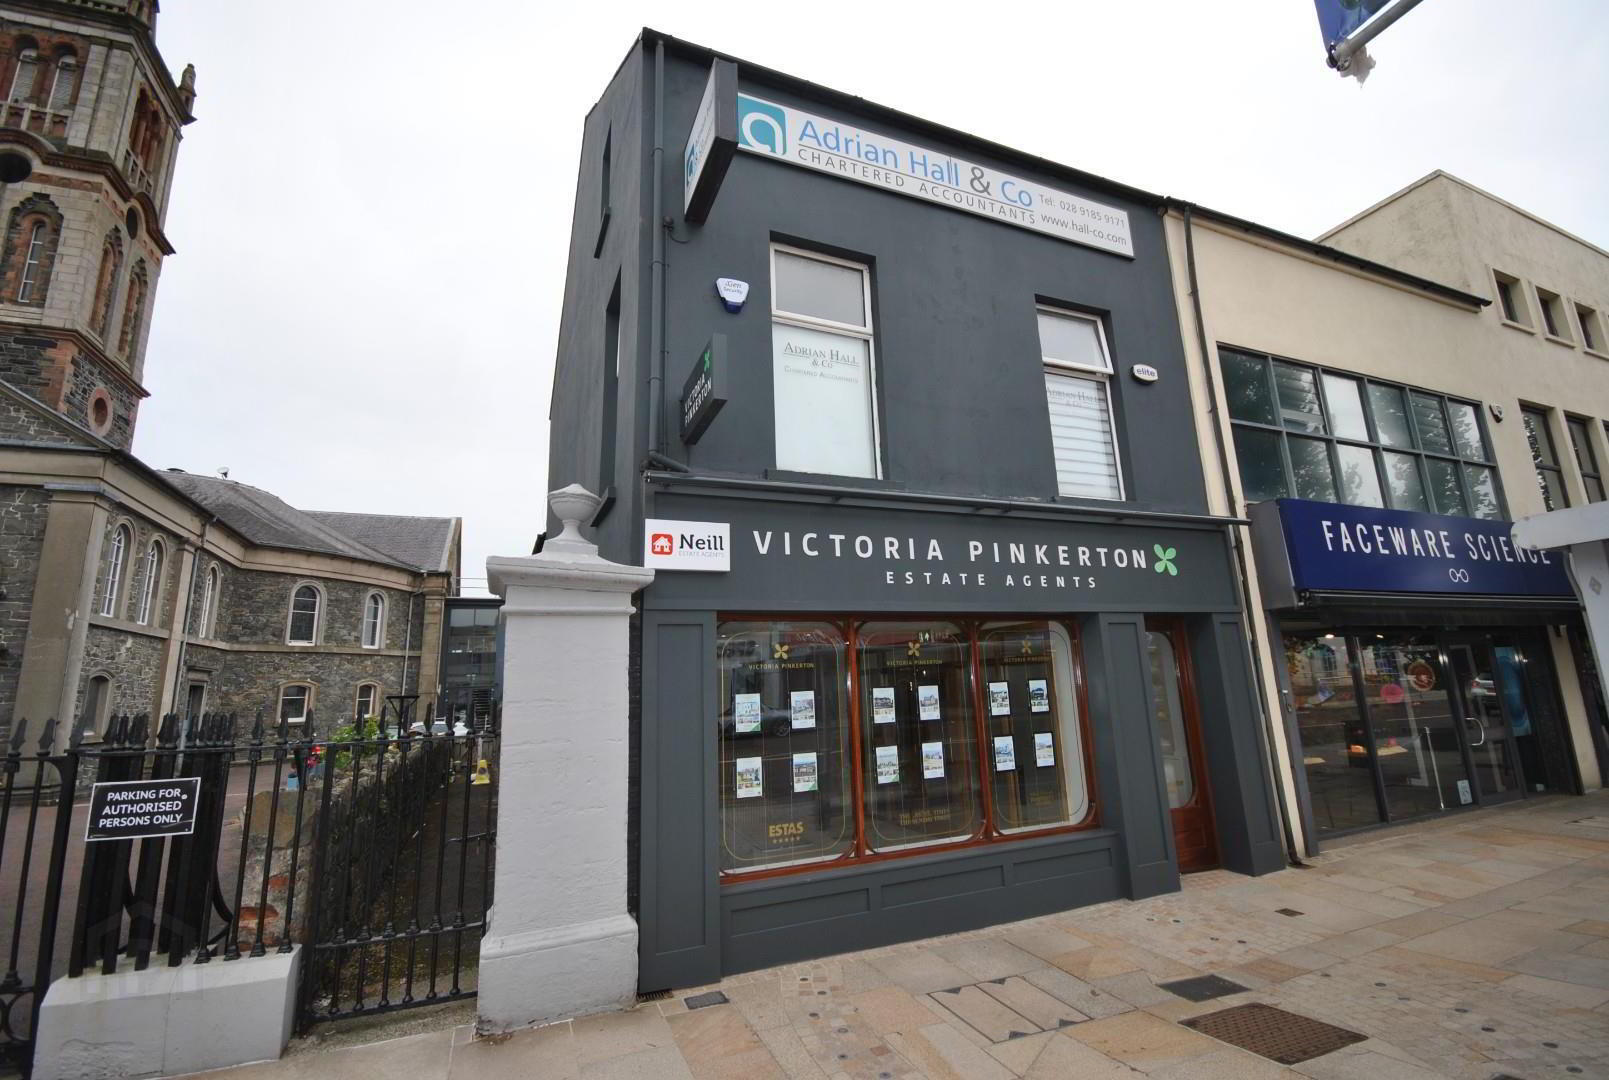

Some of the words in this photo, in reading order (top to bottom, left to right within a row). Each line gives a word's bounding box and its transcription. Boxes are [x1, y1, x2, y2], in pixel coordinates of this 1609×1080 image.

[799, 120, 898, 168] Adrian
[909, 151, 960, 187] Hall
[969, 166, 992, 196] &
[1001, 181, 1033, 207] Co
[798, 149, 905, 187] CHARTERED
[919, 183, 1036, 224] ACCOUNTANTS
[1059, 200, 1077, 214] 028
[1040, 214, 1127, 246] www.hall-co.com
[784, 341, 826, 359] ADRIAN
[679, 533, 724, 551] Neill
[1321, 520, 1455, 559] FACEWARE
[753, 530, 944, 561] VICTORIA
[968, 541, 1147, 569] PINKERTON
[886, 571, 985, 586] ESTATE
[1006, 575, 1096, 588] AGENTS
[107, 790, 156, 802] PARKING
[158, 788, 181, 798] FOR
[102, 801, 183, 815] AUTHORISED
[98, 816, 151, 828] PERSONS
[153, 813, 183, 825] ONLY
[768, 822, 805, 838] ESTAS
